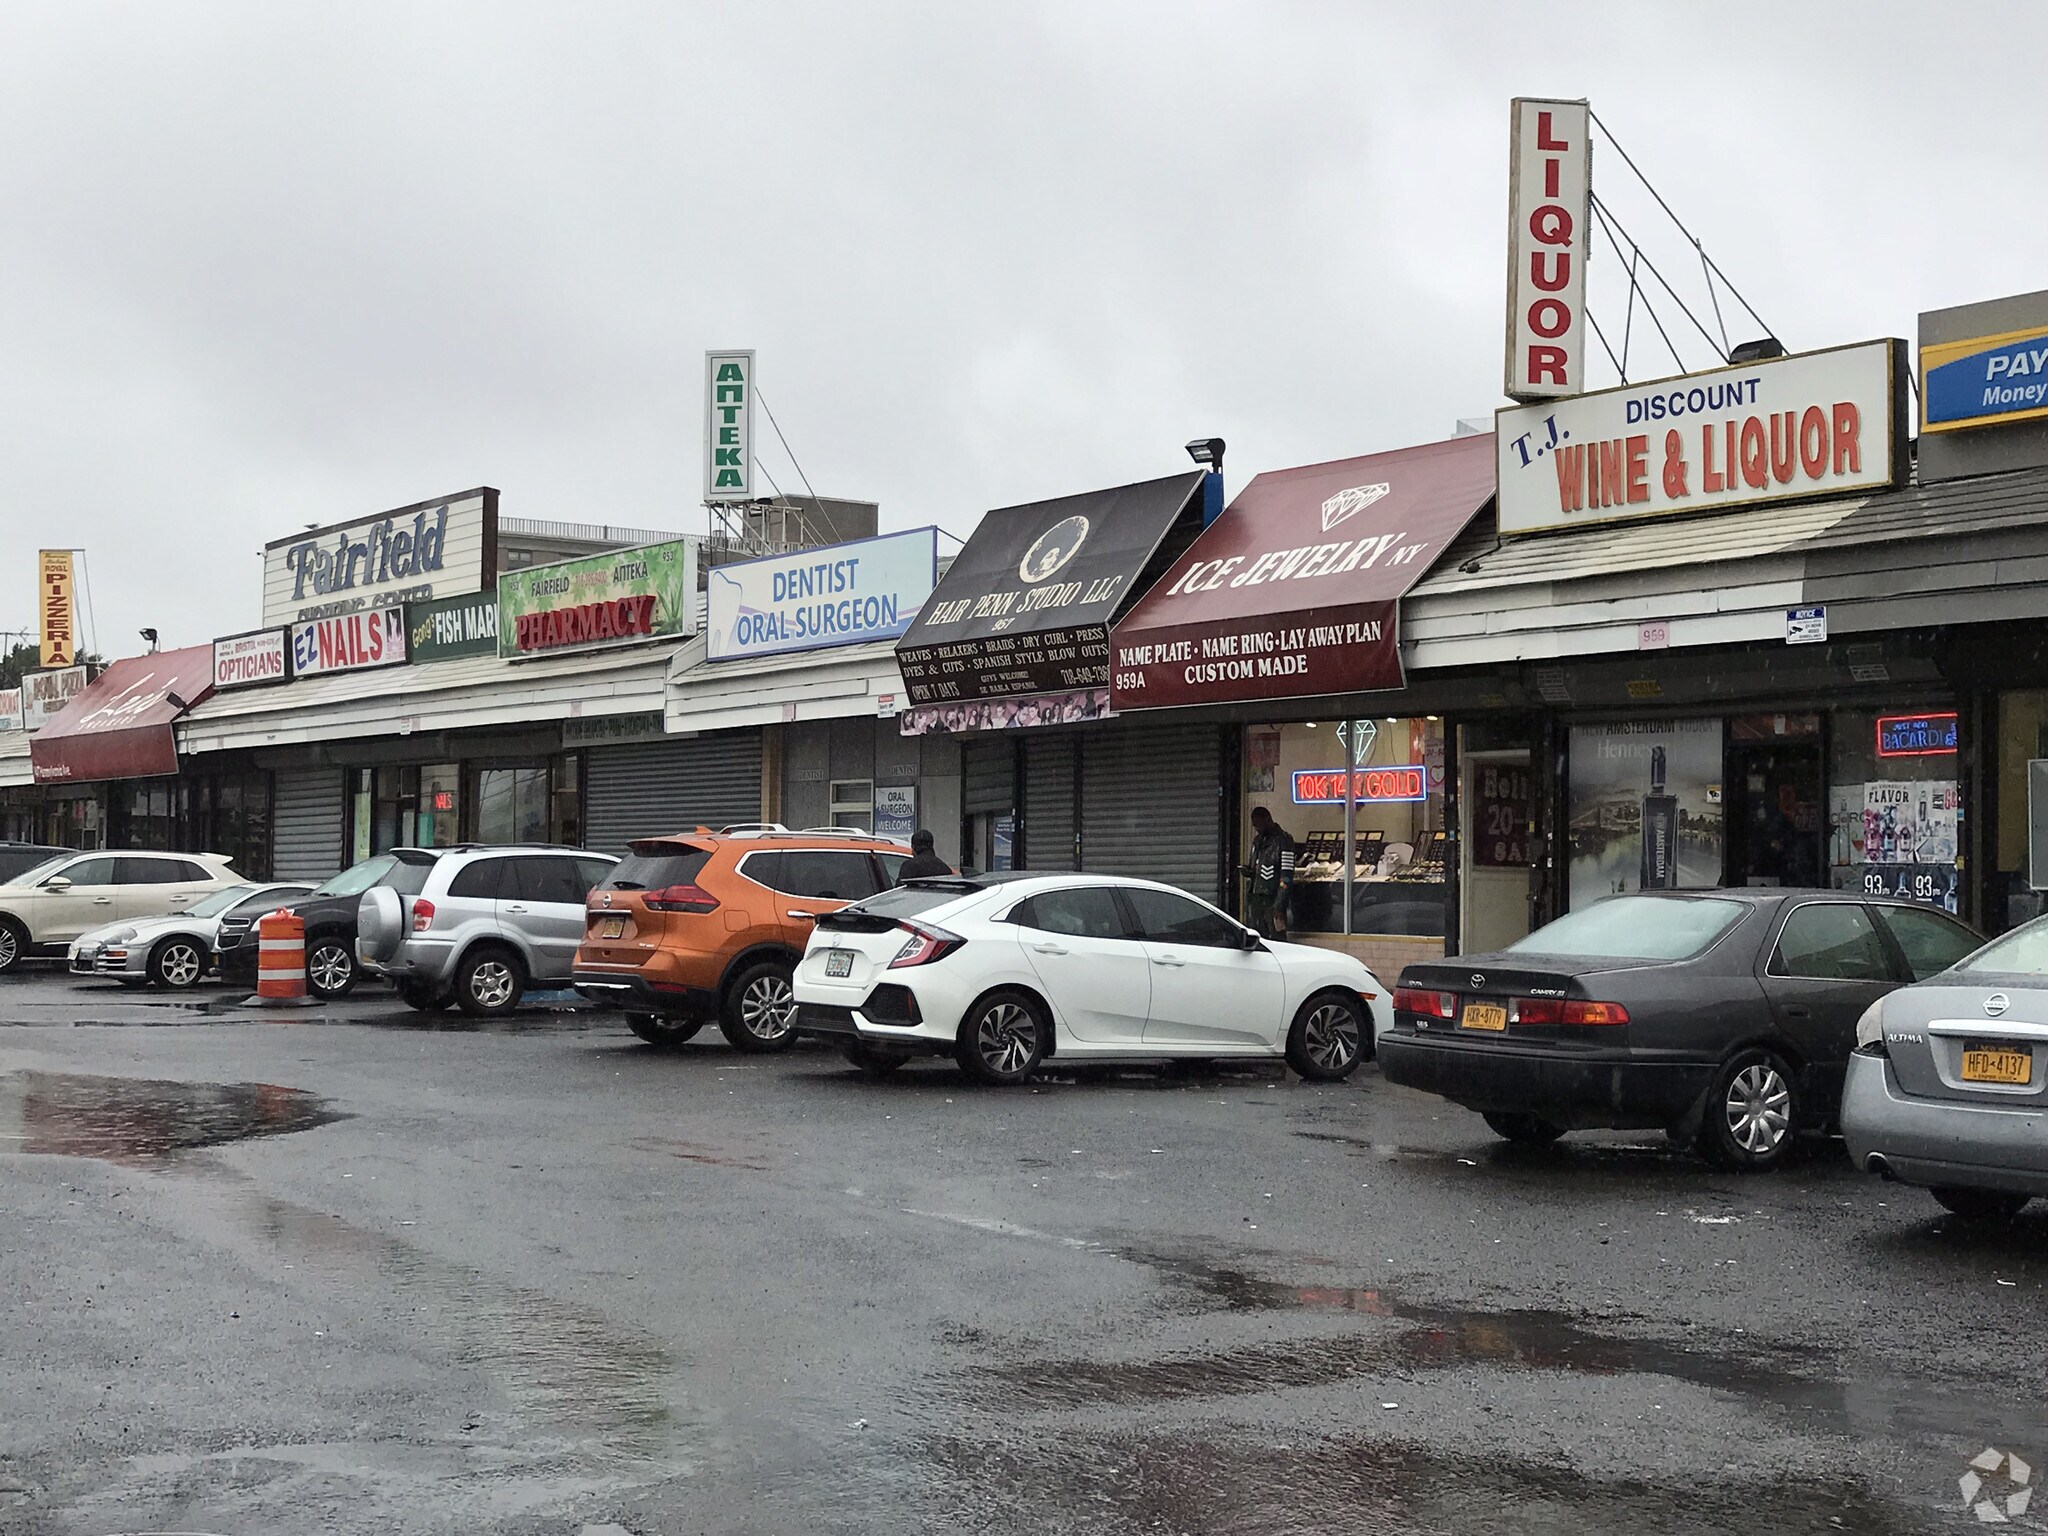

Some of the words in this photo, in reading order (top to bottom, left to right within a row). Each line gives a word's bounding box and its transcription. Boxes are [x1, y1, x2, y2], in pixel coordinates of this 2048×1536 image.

[1527, 112, 1573, 386] LIQUOR
[1626, 378, 1762, 425] DISCOUNT
[1982, 383, 2047, 406] Money
[715, 363, 744, 487] АПТЕКА
[1510, 415, 1571, 468] T.J.
[1555, 434, 1651, 513] WINE
[1663, 429, 1691, 500] &
[1702, 401, 1862, 494] LIQUOR
[286, 504, 449, 600] Fairfield
[1166, 555, 1246, 596] ICE
[1231, 532, 1407, 588] JEWELRY
[1385, 542, 1428, 567] NY
[531, 576, 570, 597] FAIRFIELD
[612, 561, 648, 583] АПТЕКА
[773, 558, 859, 602] DENTIST
[46, 573, 70, 663] PIZZERIA
[925, 599, 971, 625] HAIR
[967, 592, 1020, 619] PENN
[1016, 582, 1082, 613] STUDIO
[1079, 575, 1123, 605] LLC
[435, 608, 462, 645] FISH
[465, 603, 498, 640] MAR
[515, 595, 655, 650] PHARMACY
[737, 609, 790, 645] ORAL
[794, 593, 898, 637] SURGEON
[991, 618, 1015, 630] 957
[1643, 629, 1665, 641] 959
[294, 625, 318, 670] EZ
[317, 613, 382, 669] NAILS
[899, 649, 931, 663] WEAVES
[938, 643, 978, 658] RELAXERS
[986, 639, 1015, 651] BRAIDS
[1023, 635, 1040, 647] DRY
[1045, 633, 1068, 645] CURL
[1076, 627, 1104, 641] PRESS
[1119, 646, 1152, 667] NAME
[1154, 641, 1191, 663] PLATE
[1202, 636, 1239, 658] NAME
[1241, 632, 1274, 653] RING
[1279, 629, 1306, 651] LAY
[1307, 624, 1345, 648] AWAY
[1346, 620, 1382, 643] PLAN
[218, 651, 281, 682] OPTICIANS
[903, 666, 924, 678] DYES
[929, 665, 939, 676] &
[942, 661, 965, 674] CUTS
[973, 655, 1012, 670] SPANISH
[1016, 651, 1044, 664] STYLE
[1049, 647, 1076, 661] BLOW
[1082, 643, 1109, 657] OUTS
[1115, 671, 1146, 690] 959A
[1184, 658, 1254, 685] CUSTOM
[1258, 654, 1308, 679] MADE
[912, 684, 929, 700] OPEN
[931, 685, 937, 699] 7
[938, 681, 960, 698] DAYS
[888, 792, 905, 801] ORAL
[1297, 775, 1327, 799] 10K
[1367, 771, 1421, 797] GOLD
[1868, 790, 1910, 803] FLAVOR
[877, 820, 912, 831] WELCOME
[880, 803, 912, 815] SURGEON
[1865, 875, 1883, 895] 93
[1915, 875, 1933, 897] 93
[1888, 1033, 1923, 1044] ALTIMA
